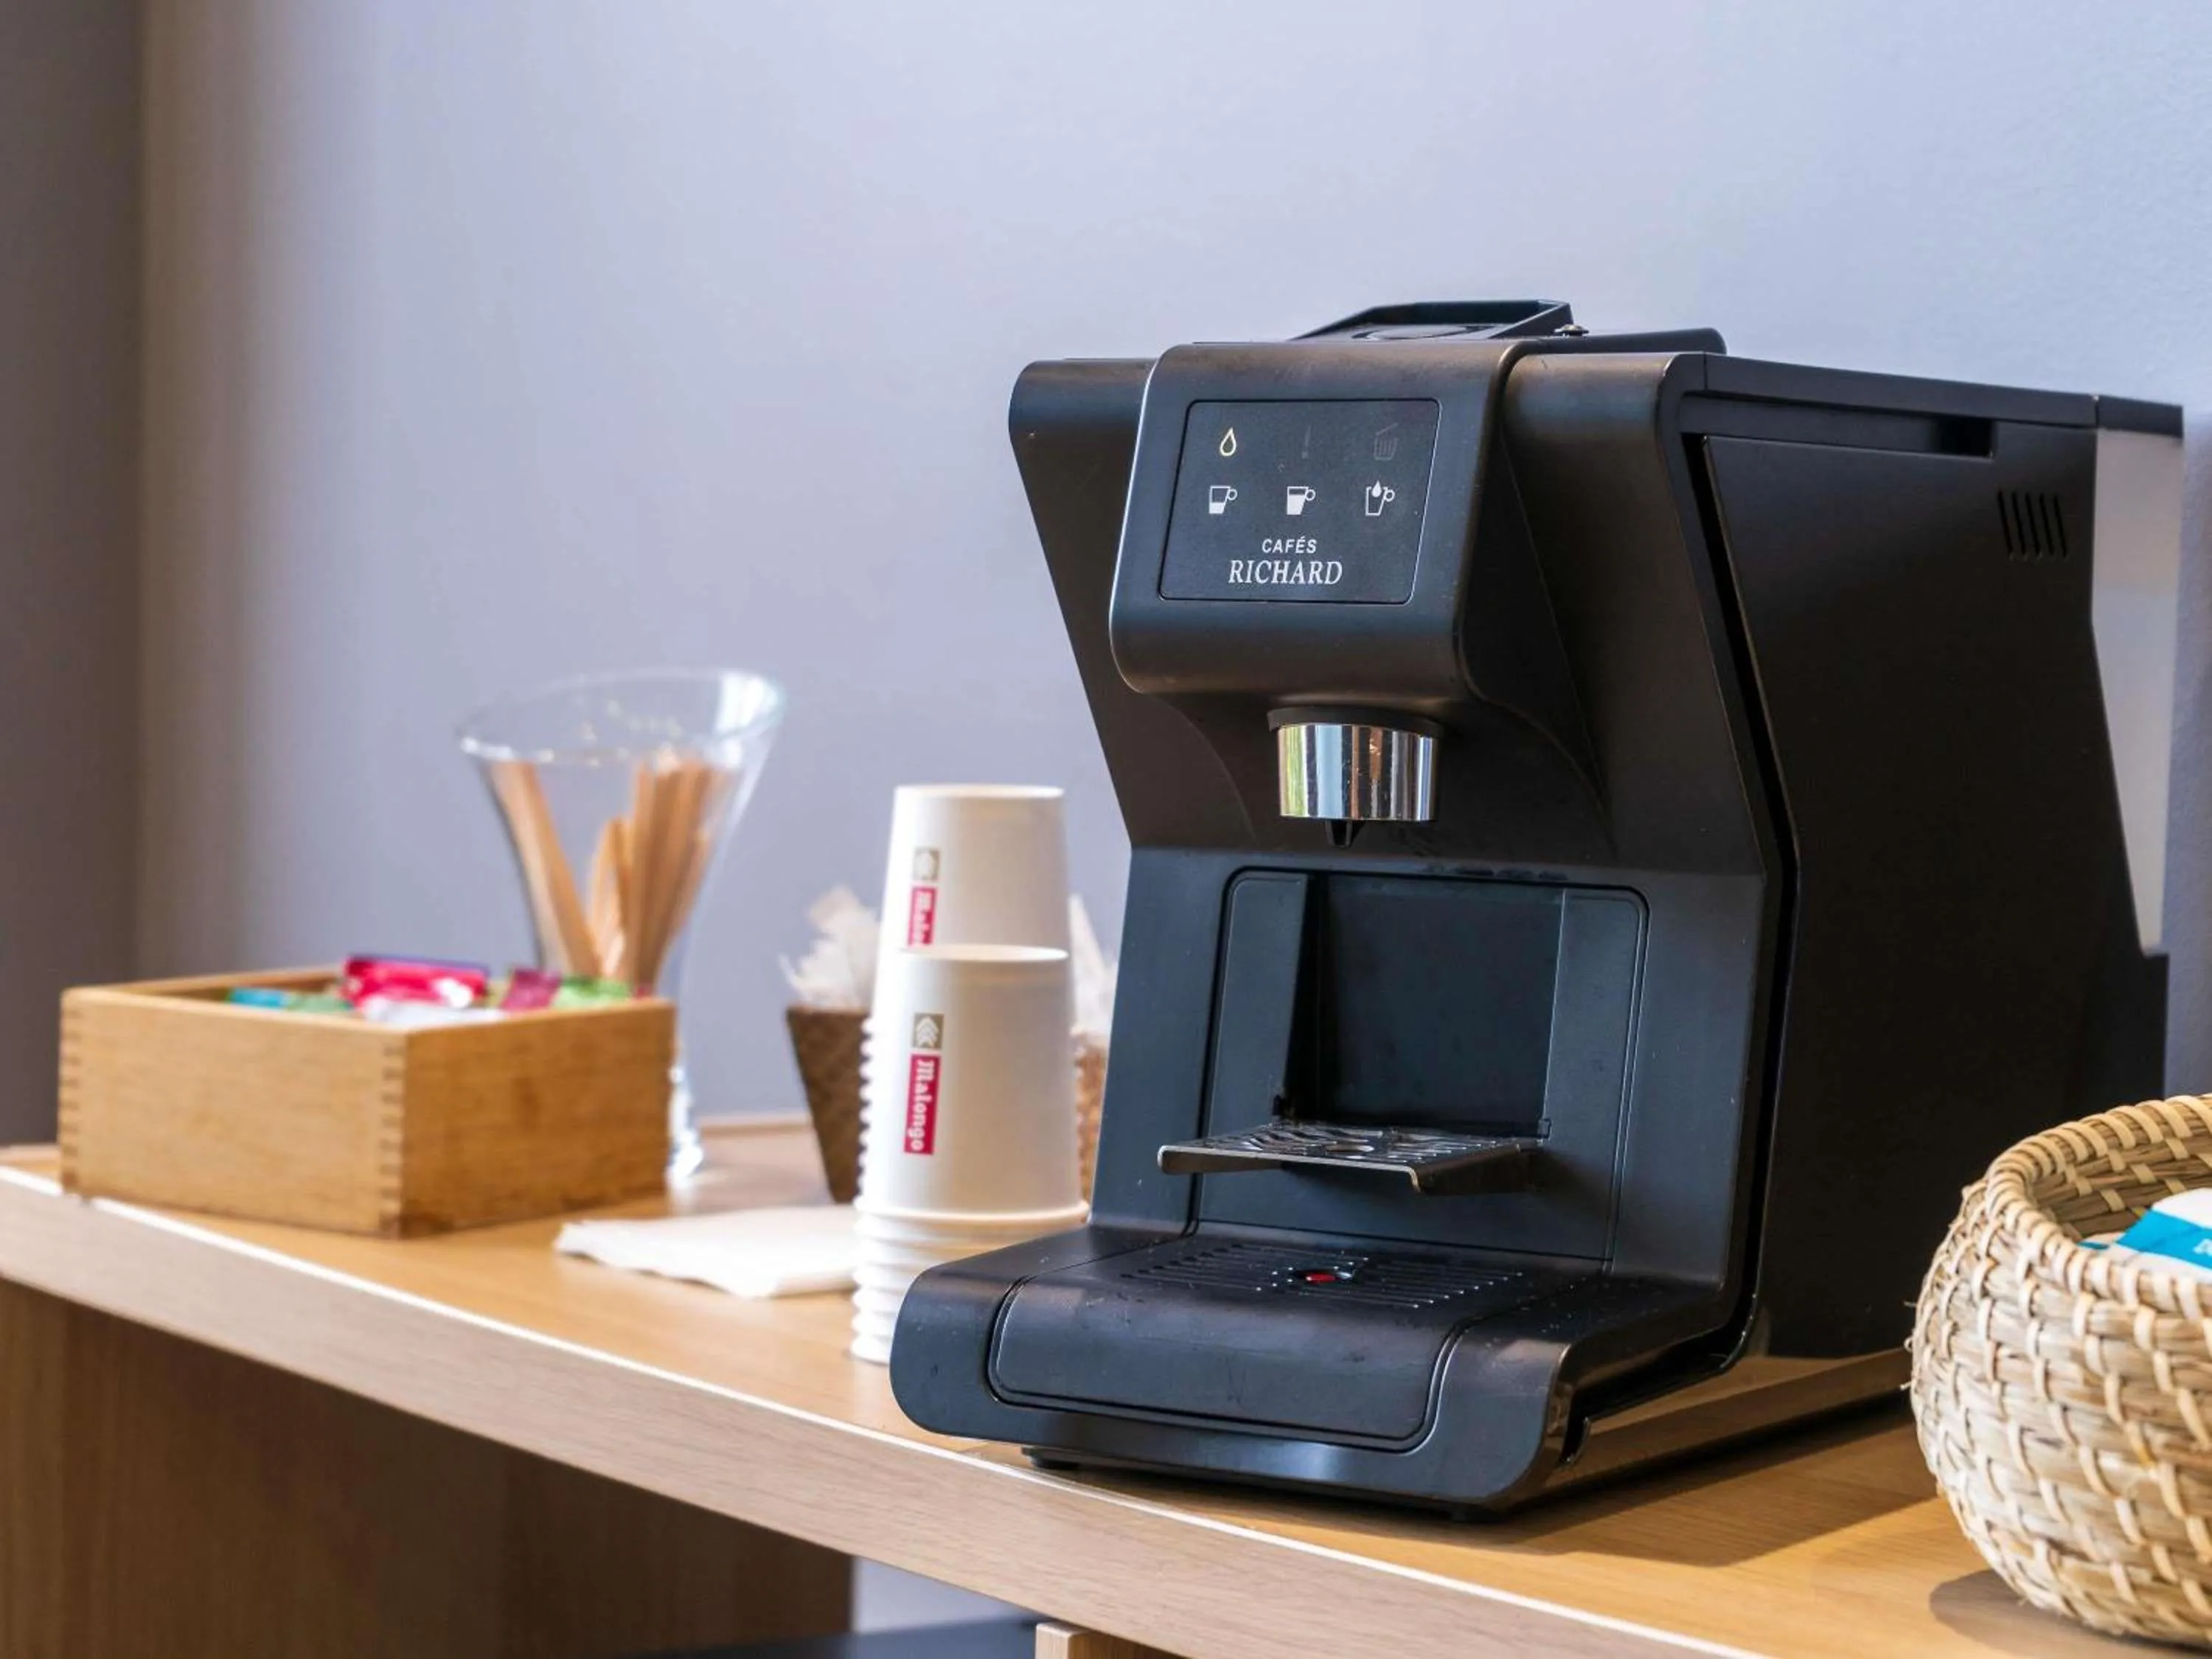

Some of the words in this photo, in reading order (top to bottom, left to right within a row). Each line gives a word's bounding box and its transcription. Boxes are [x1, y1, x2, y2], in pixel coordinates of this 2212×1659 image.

[1262, 535, 1317, 554] CAFÉS
[1228, 560, 1343, 585] RICHARD
[908, 1059, 935, 1151] Malongo
